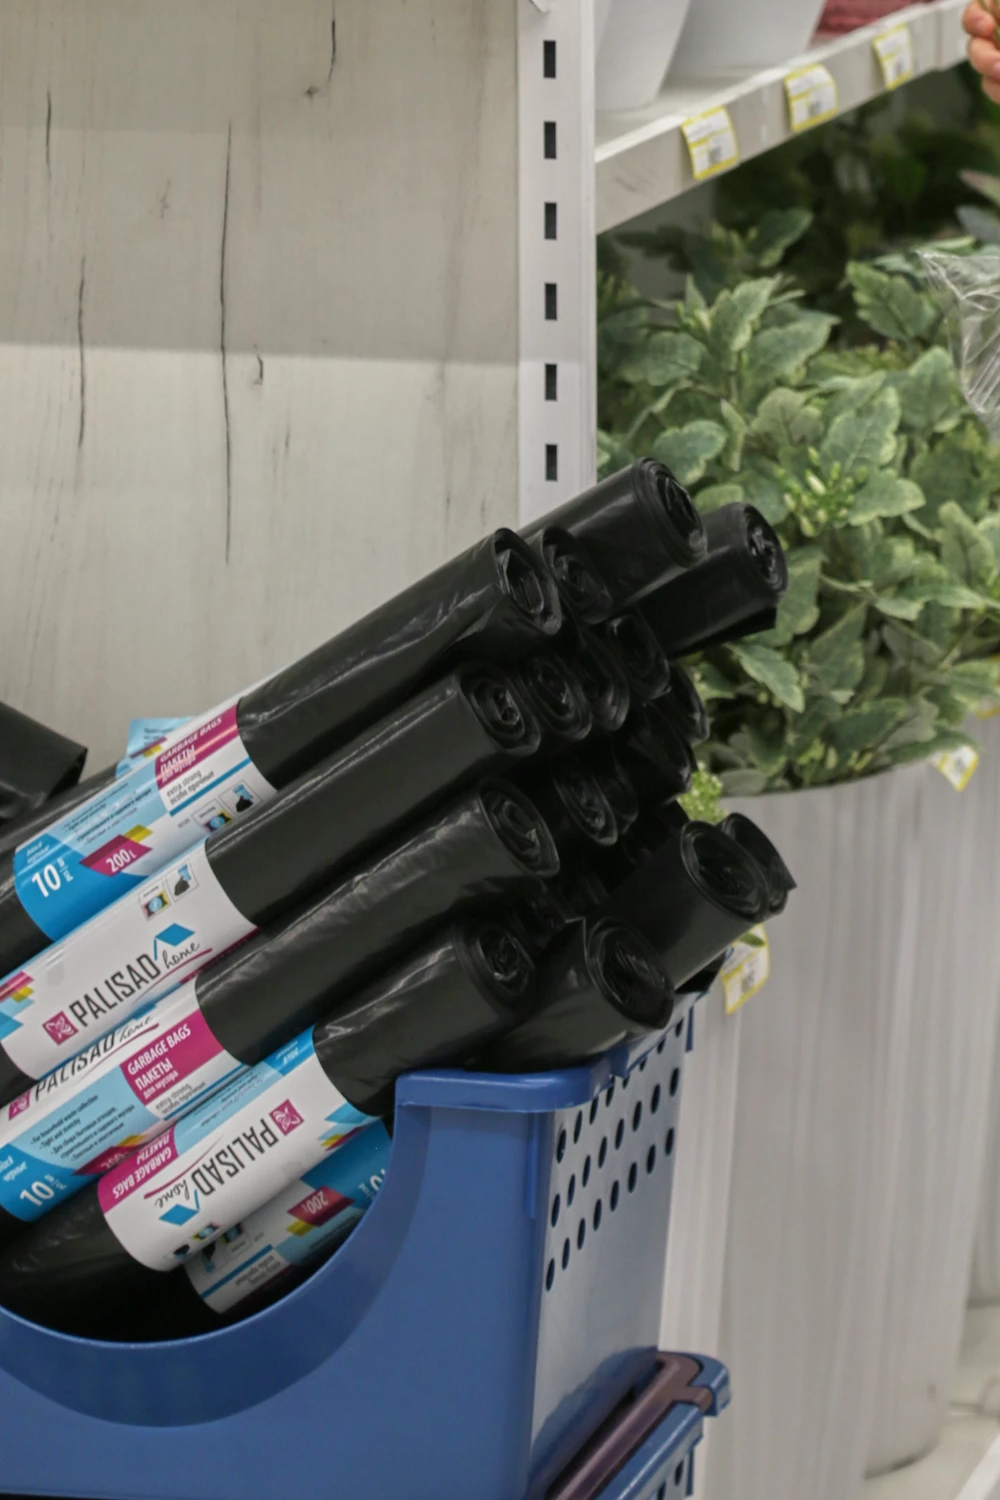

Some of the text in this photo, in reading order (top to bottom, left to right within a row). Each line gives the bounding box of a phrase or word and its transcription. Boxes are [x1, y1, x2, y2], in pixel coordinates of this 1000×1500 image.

[160, 731, 198, 762] GARBAGE
[199, 716, 222, 736] BAGS
[160, 744, 195, 773] ПАКЕТЫ
[181, 769, 201, 786] strong
[30, 863, 62, 897] 10
[69, 939, 200, 1028] PALISAD home
[126, 1023, 191, 1075] GARBAGE BAGS
[134, 1057, 173, 1090] ПАКЕТЫ
[143, 1069, 178, 1098] для мусора
[111, 1146, 172, 1199] GARBAGE BAGS
[153, 1117, 279, 1210] PALISAD home
[19, 1181, 54, 1205] 10
